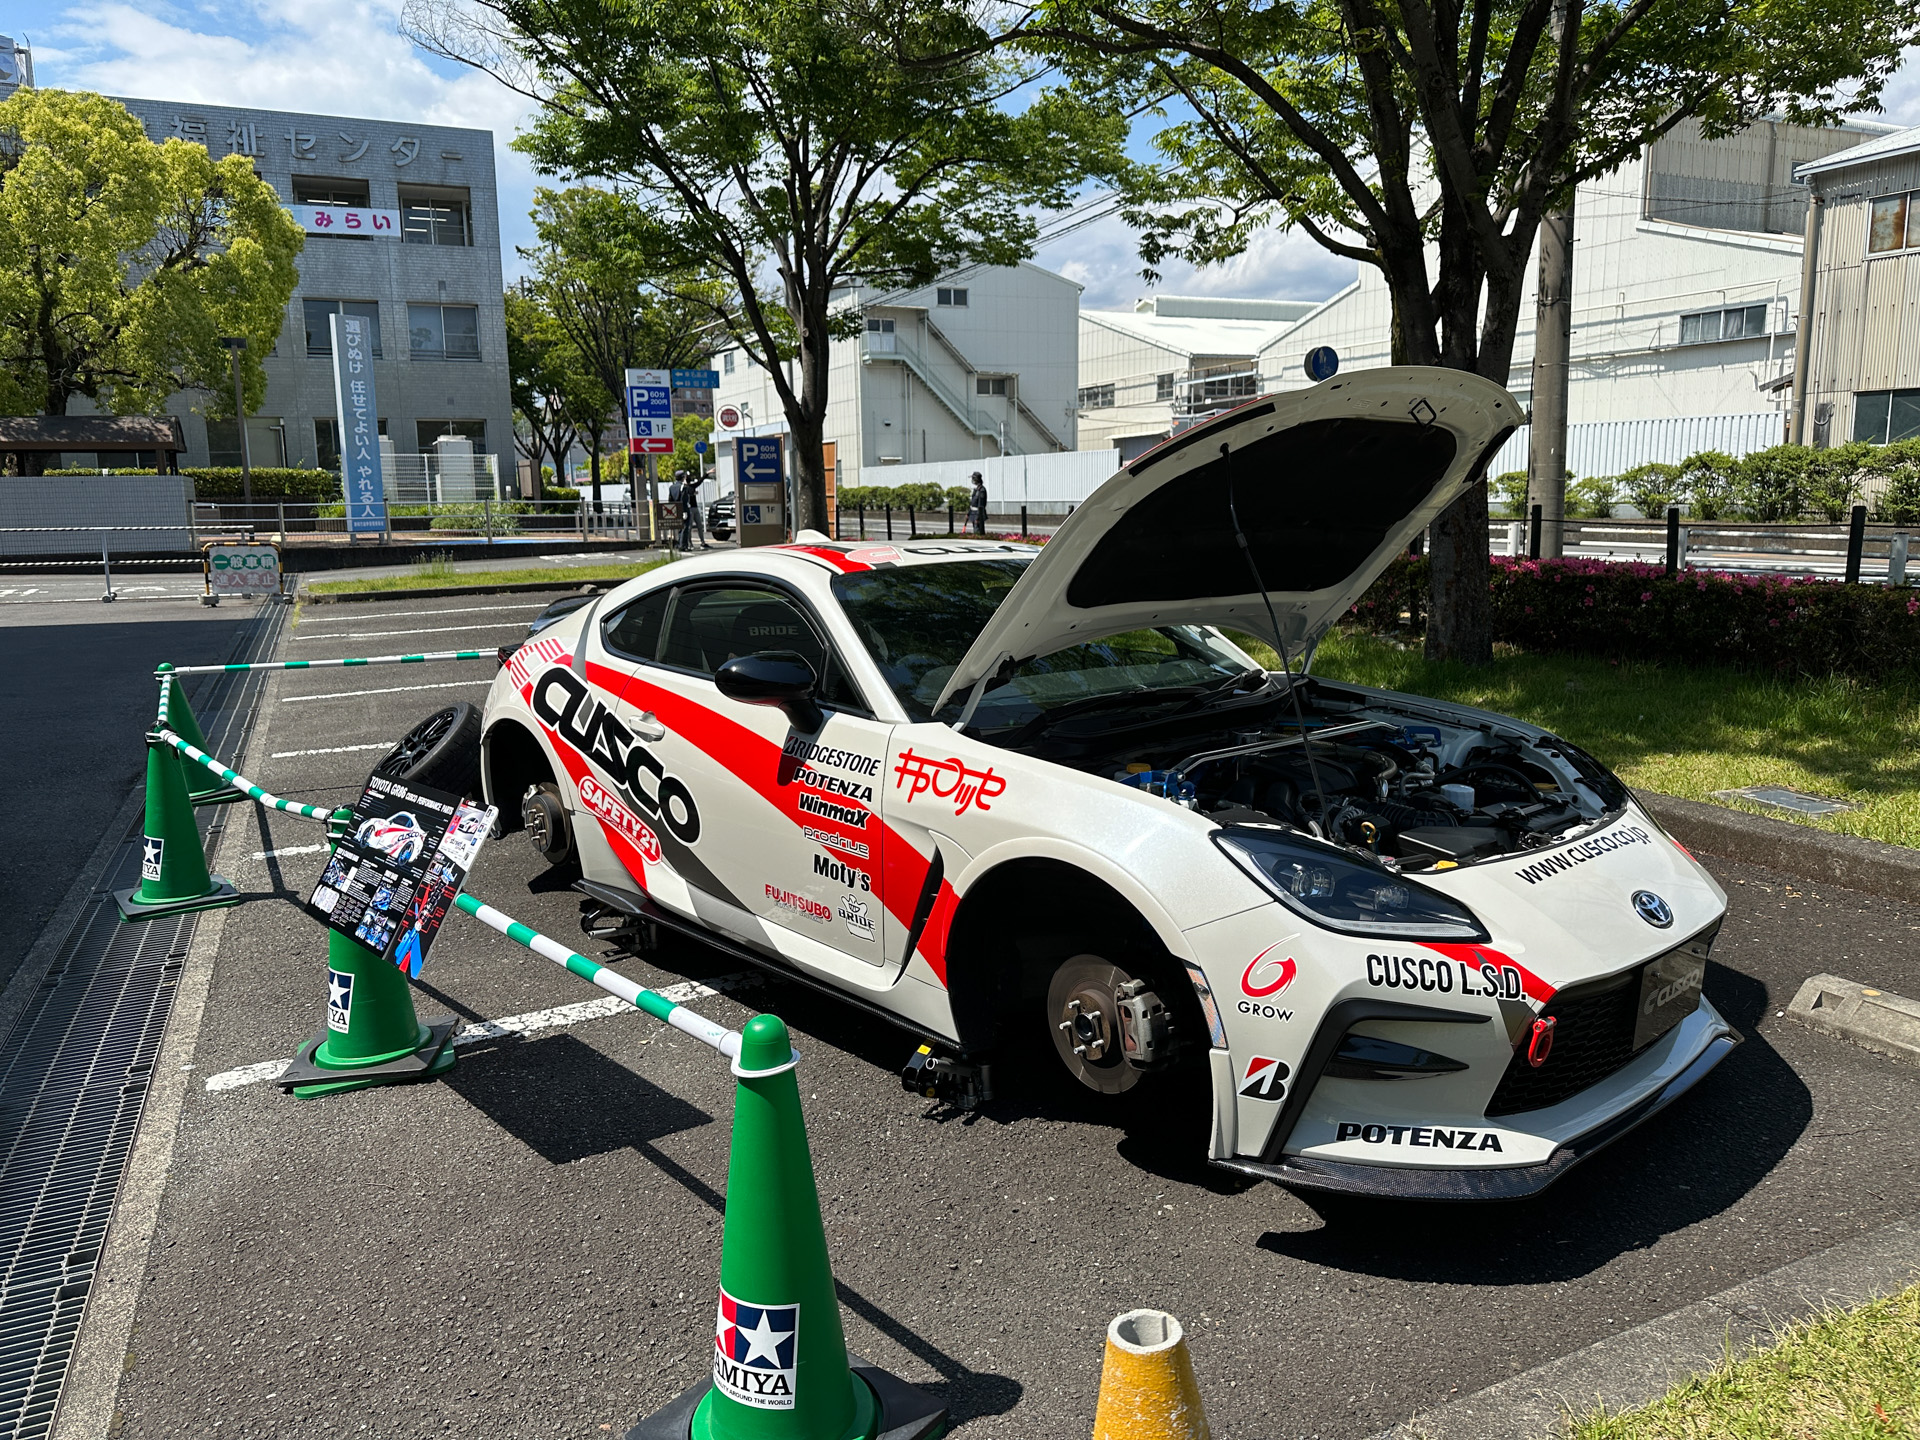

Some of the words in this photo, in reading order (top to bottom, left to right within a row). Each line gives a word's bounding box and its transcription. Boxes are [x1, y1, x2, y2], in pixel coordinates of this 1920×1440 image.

[133, 111, 463, 167] 福祉センター
[314, 211, 391, 230] みらい
[345, 319, 364, 374] 選びぬけ
[649, 390, 665, 398] 60分
[650, 398, 668, 406] 200円
[350, 380, 371, 460] 任せてよい人
[656, 424, 667, 433] 1F
[357, 465, 375, 517] やれる人
[216, 573, 274, 586] 進入禁止
[748, 625, 799, 636] BRIDE
[533, 666, 702, 844] CUSCO
[783, 736, 881, 777] BRIDGESTONE
[369, 776, 393, 794] TOYOTA
[390, 783, 409, 799] GR86
[793, 767, 873, 803] POTENZA
[397, 831, 419, 842] CUSCO
[813, 853, 871, 892] Moty's
[765, 884, 833, 922] FUJITSUBO
[838, 907, 876, 931] BRIDE
[1366, 954, 1453, 993] CUSCO
[1459, 962, 1527, 1001] L.S.D.
[1657, 968, 1700, 1007] CUSCO
[1237, 1001, 1294, 1022] GROW
[1336, 1122, 1504, 1153] POTENZA
[729, 1389, 753, 1402] AROUND
[753, 1397, 766, 1405] THE
